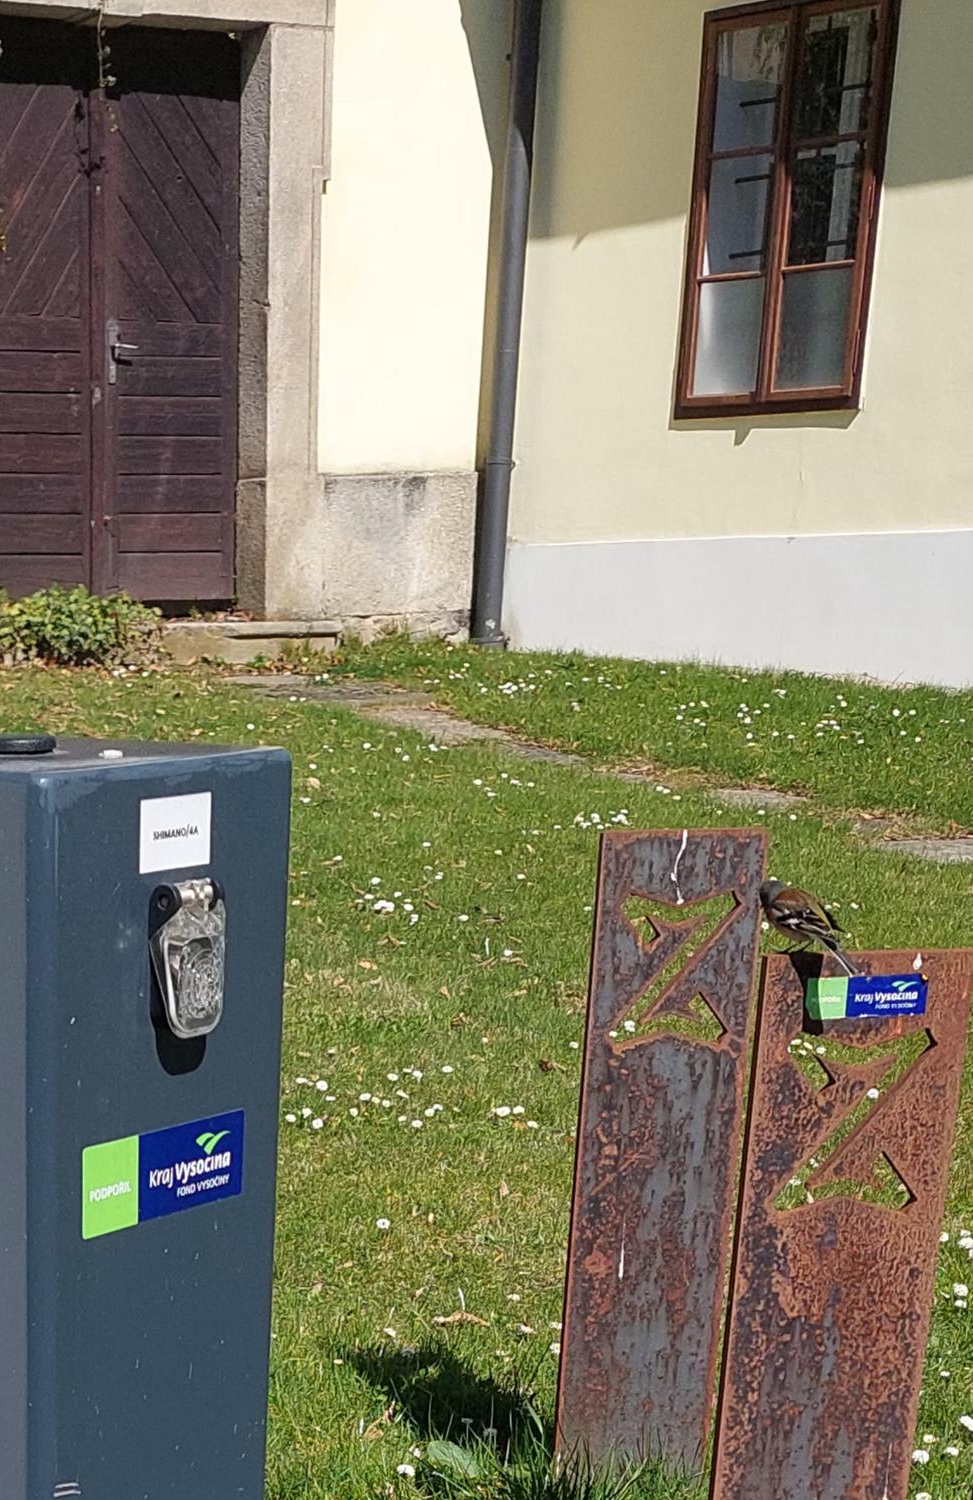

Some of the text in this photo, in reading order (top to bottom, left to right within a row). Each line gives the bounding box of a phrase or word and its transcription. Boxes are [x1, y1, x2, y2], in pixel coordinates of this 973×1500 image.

[152, 824, 200, 841] SHIMANO/4A
[148, 1167, 174, 1189] Kraj
[176, 1183, 196, 1198] FOND
